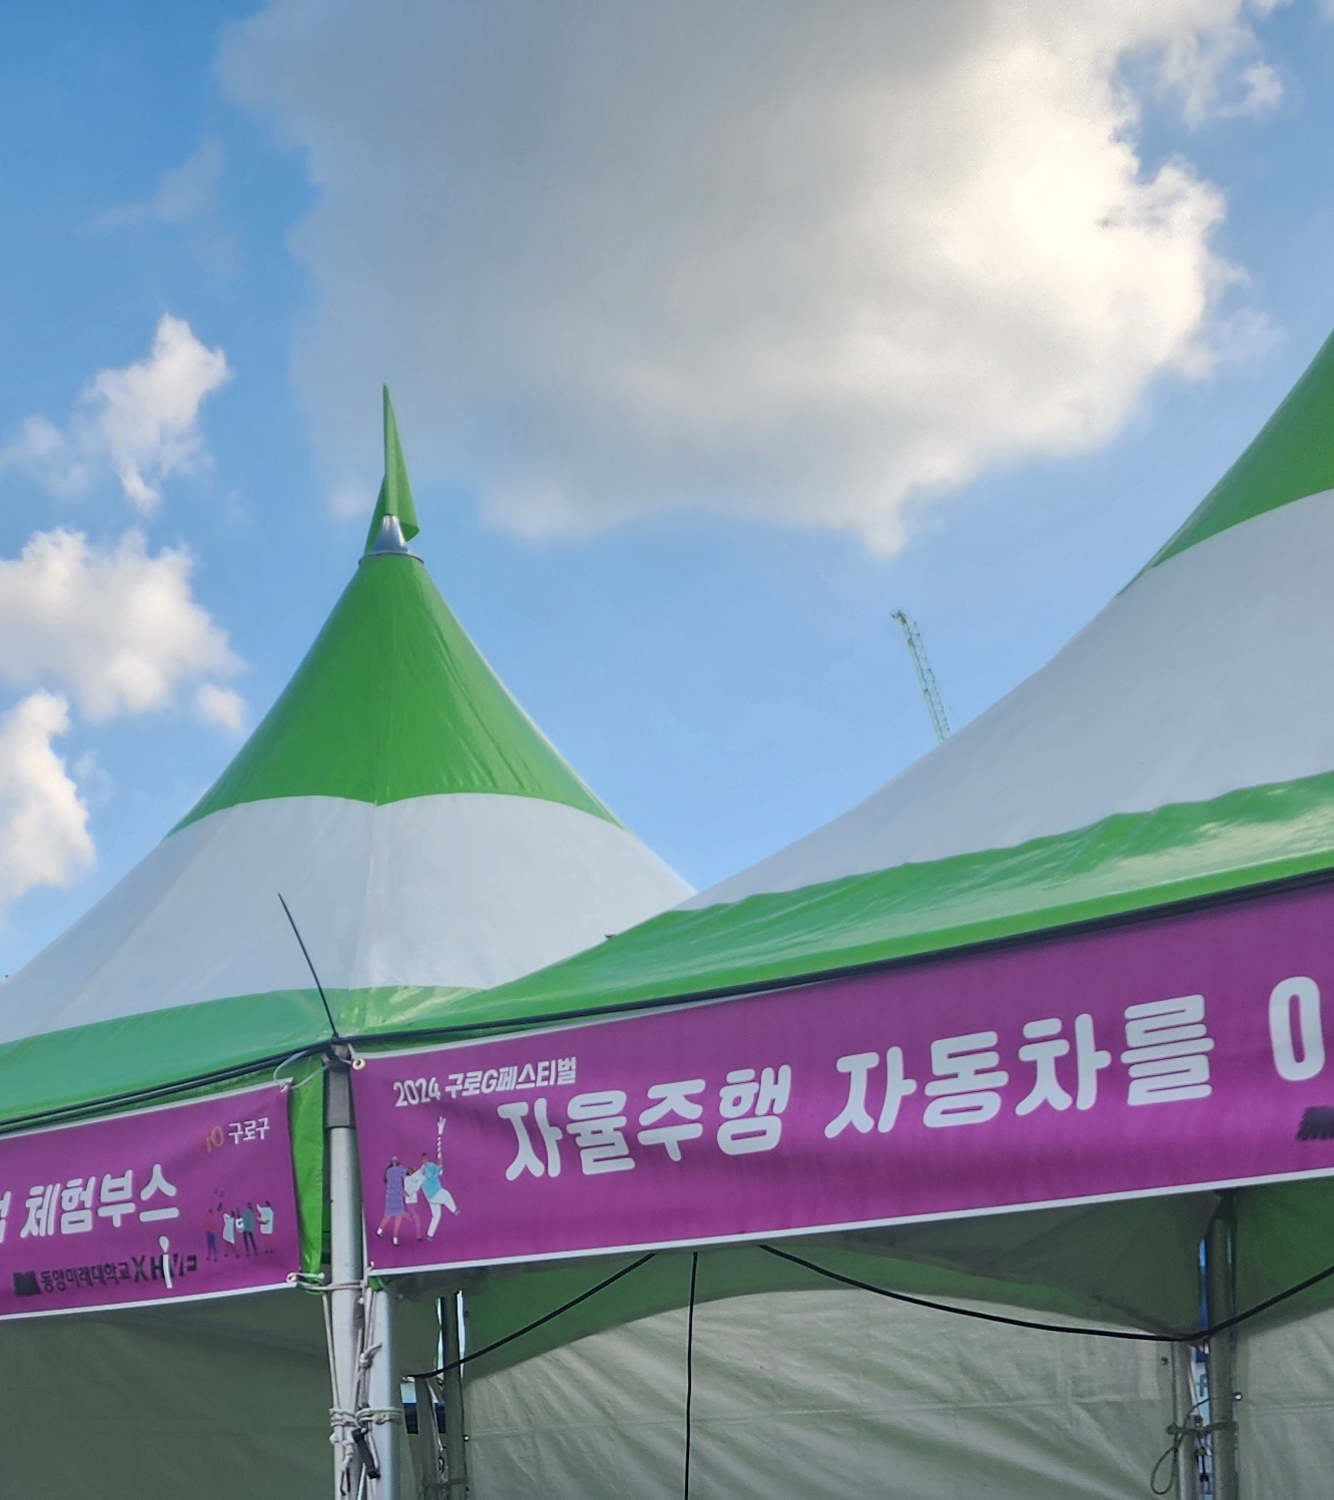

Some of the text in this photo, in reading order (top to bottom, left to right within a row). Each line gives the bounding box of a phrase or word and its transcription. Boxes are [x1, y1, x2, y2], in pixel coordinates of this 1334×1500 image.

[393, 1056, 577, 1107] 2024 구로G페스티벌
[497, 1064, 792, 1181] 자율주행
[824, 994, 1216, 1139] 자동차를
[228, 1117, 270, 1144] 구로구
[20, 1164, 180, 1238] 체험부스
[41, 1262, 131, 1294] 동양미래대학교
